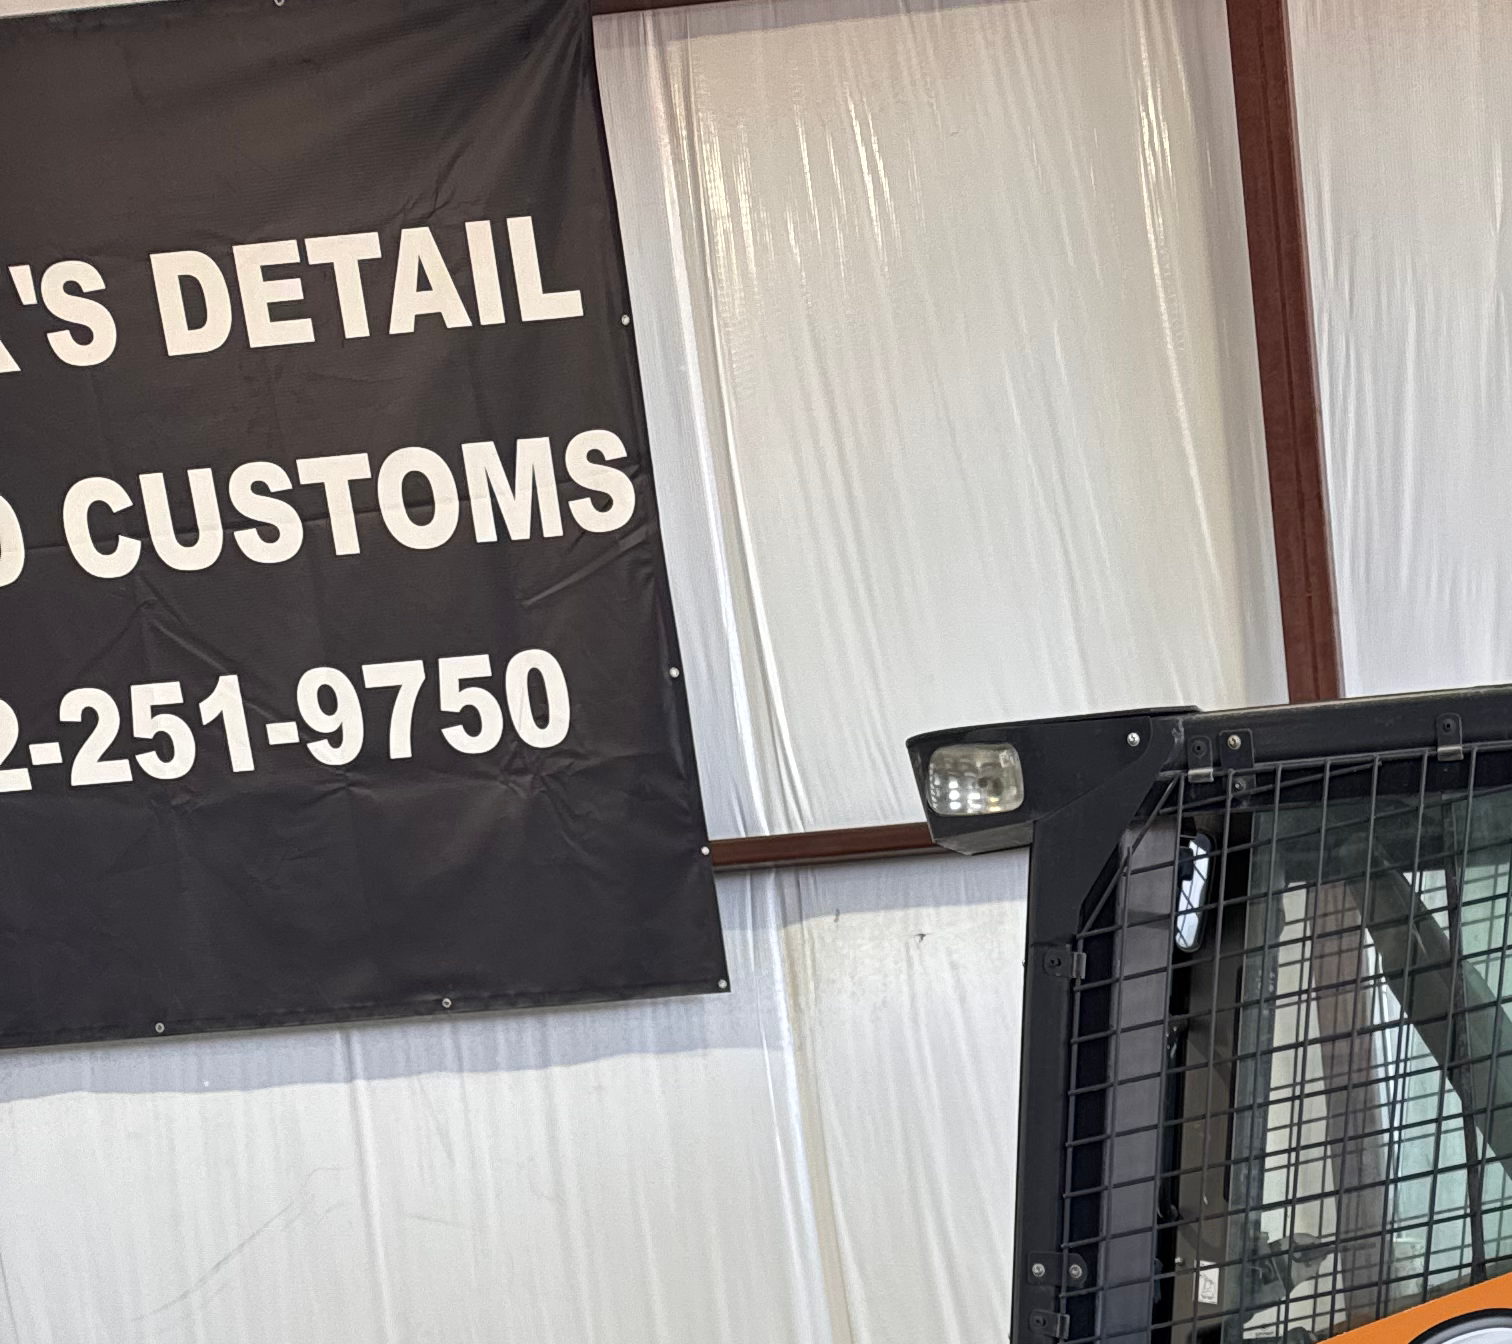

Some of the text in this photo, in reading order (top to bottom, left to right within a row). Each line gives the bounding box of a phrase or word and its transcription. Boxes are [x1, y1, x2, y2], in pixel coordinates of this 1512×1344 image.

[0, 215, 584, 373] 'S DETAIL
[62, 429, 637, 579] CUSTOMS
